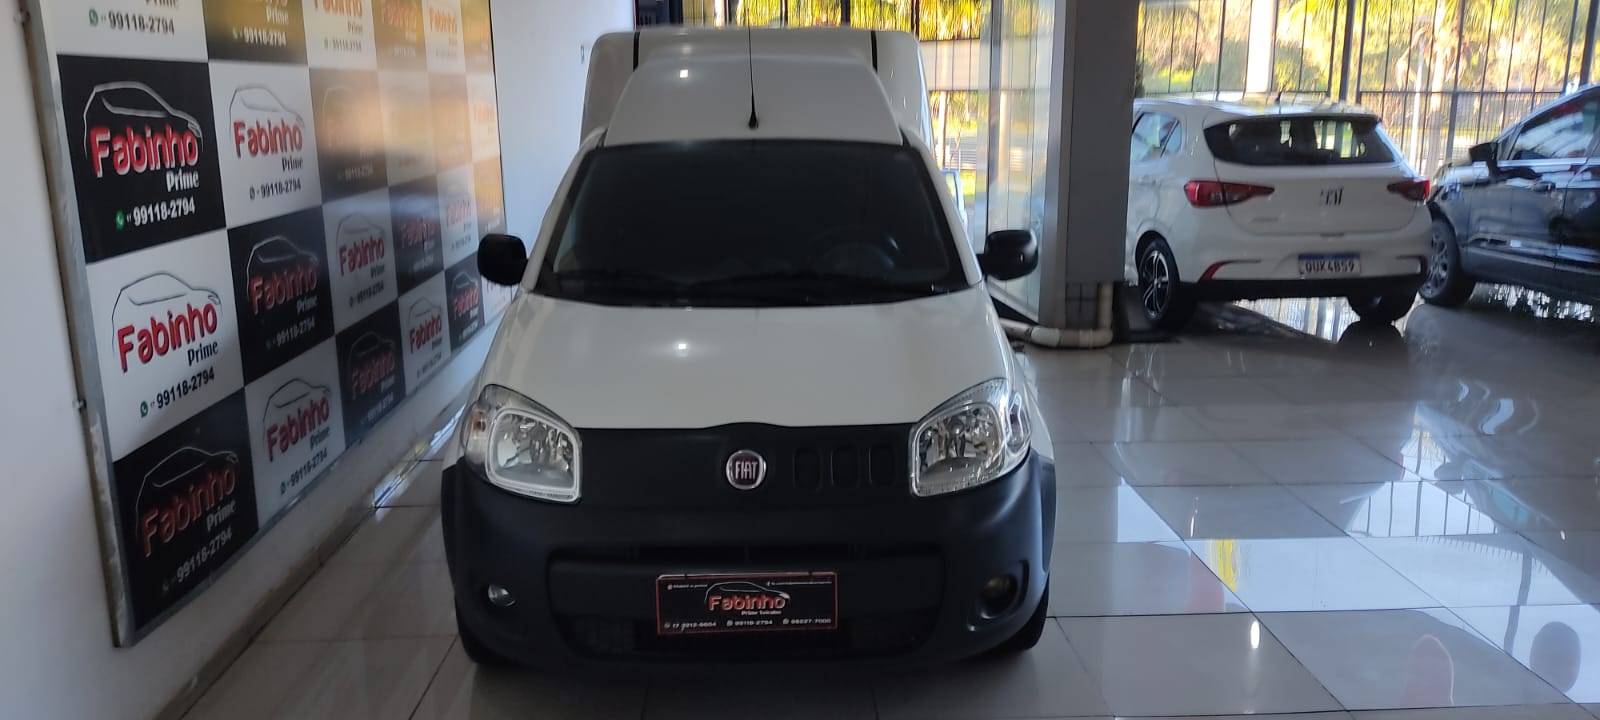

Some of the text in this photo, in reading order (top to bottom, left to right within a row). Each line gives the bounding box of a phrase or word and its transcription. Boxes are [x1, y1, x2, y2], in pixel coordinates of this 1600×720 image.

[108, 11, 175, 36] 99118-2794
[243, 27, 287, 47] 99118-2794
[90, 125, 199, 178] Fabinho
[233, 119, 304, 159] Fabinho
[281, 156, 304, 172] Prime
[166, 170, 199, 192] Prime
[260, 178, 302, 197] 99118-2794
[133, 199, 196, 227] 99118-2794
[339, 235, 385, 277] Fabinho
[251, 265, 318, 315] Fabinho
[117, 302, 218, 374] Fabinho
[277, 318, 315, 346] 99118-2794
[409, 314, 442, 355] Fabinho
[187, 341, 218, 366] Prime
[156, 366, 215, 409] 99118-2794
[266, 396, 330, 462] Fabinho
[291, 449, 328, 487] 99118-2794
[735, 460, 759, 480] FIAT
[142, 469, 236, 557] Fabinho
[206, 502, 236, 531] Prime
[177, 529, 233, 582] 99118-2794
[708, 595, 786, 611] Fabinho
